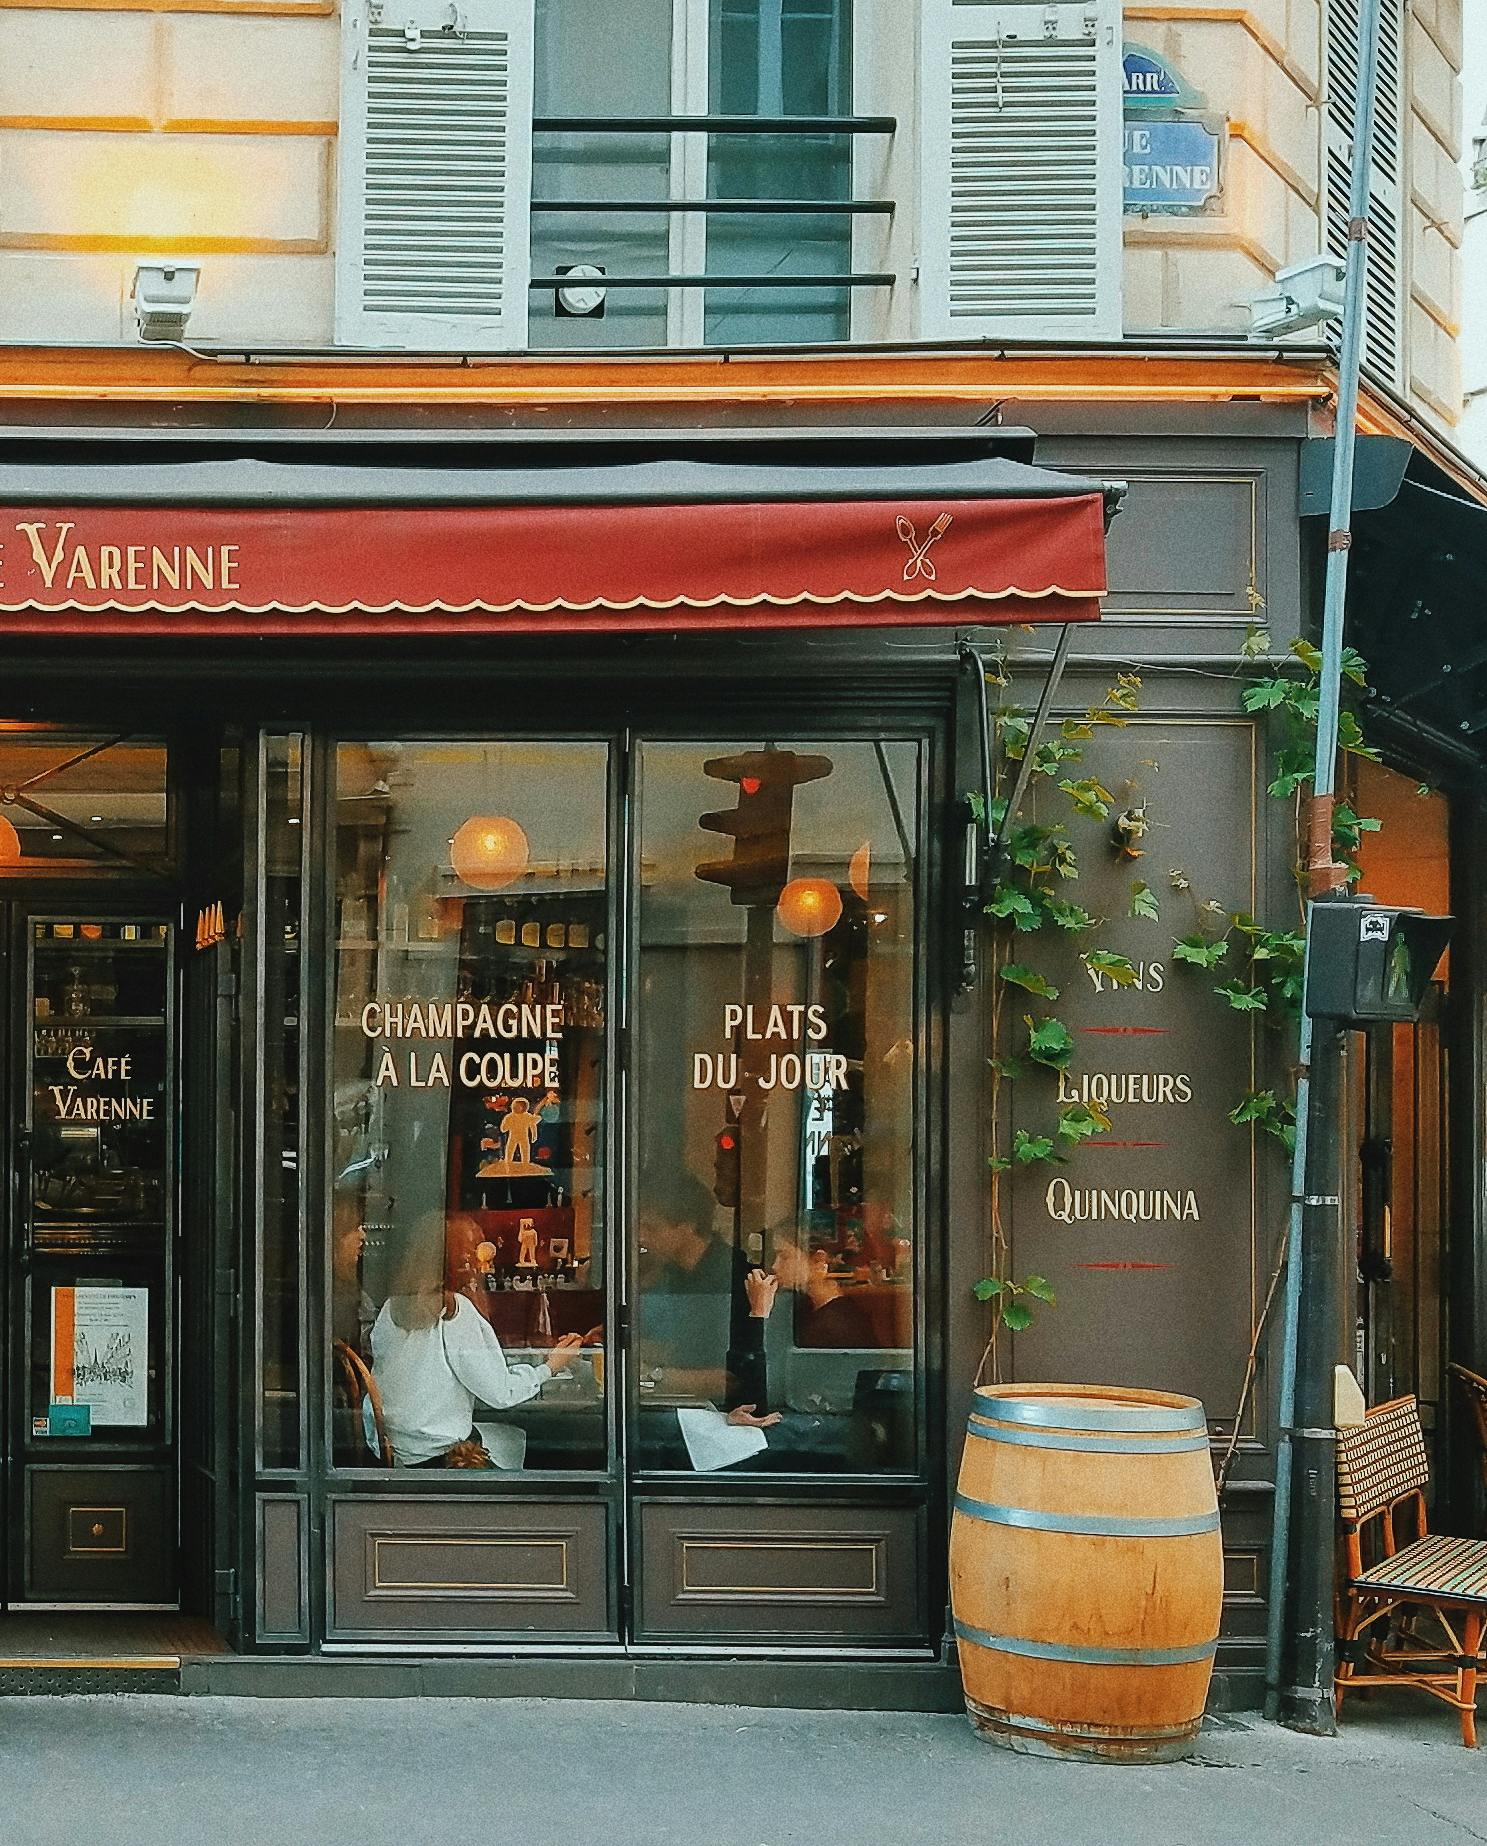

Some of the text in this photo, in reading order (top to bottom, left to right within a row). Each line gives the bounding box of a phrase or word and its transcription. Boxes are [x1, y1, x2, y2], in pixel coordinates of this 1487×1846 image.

[15, 522, 240, 590] VARENNE
[360, 1002, 564, 1039] CHAMPAGNE
[724, 1004, 828, 1040] PLATS
[67, 1046, 132, 1080] CAFÉ
[376, 1046, 560, 1088] À LA COUPE
[693, 1053, 849, 1090] DU JOUR
[49, 1086, 155, 1121] VARENNE
[1056, 1073, 1193, 1105] LIQUEURS
[1045, 1177, 1201, 1224] QUINQUINA
